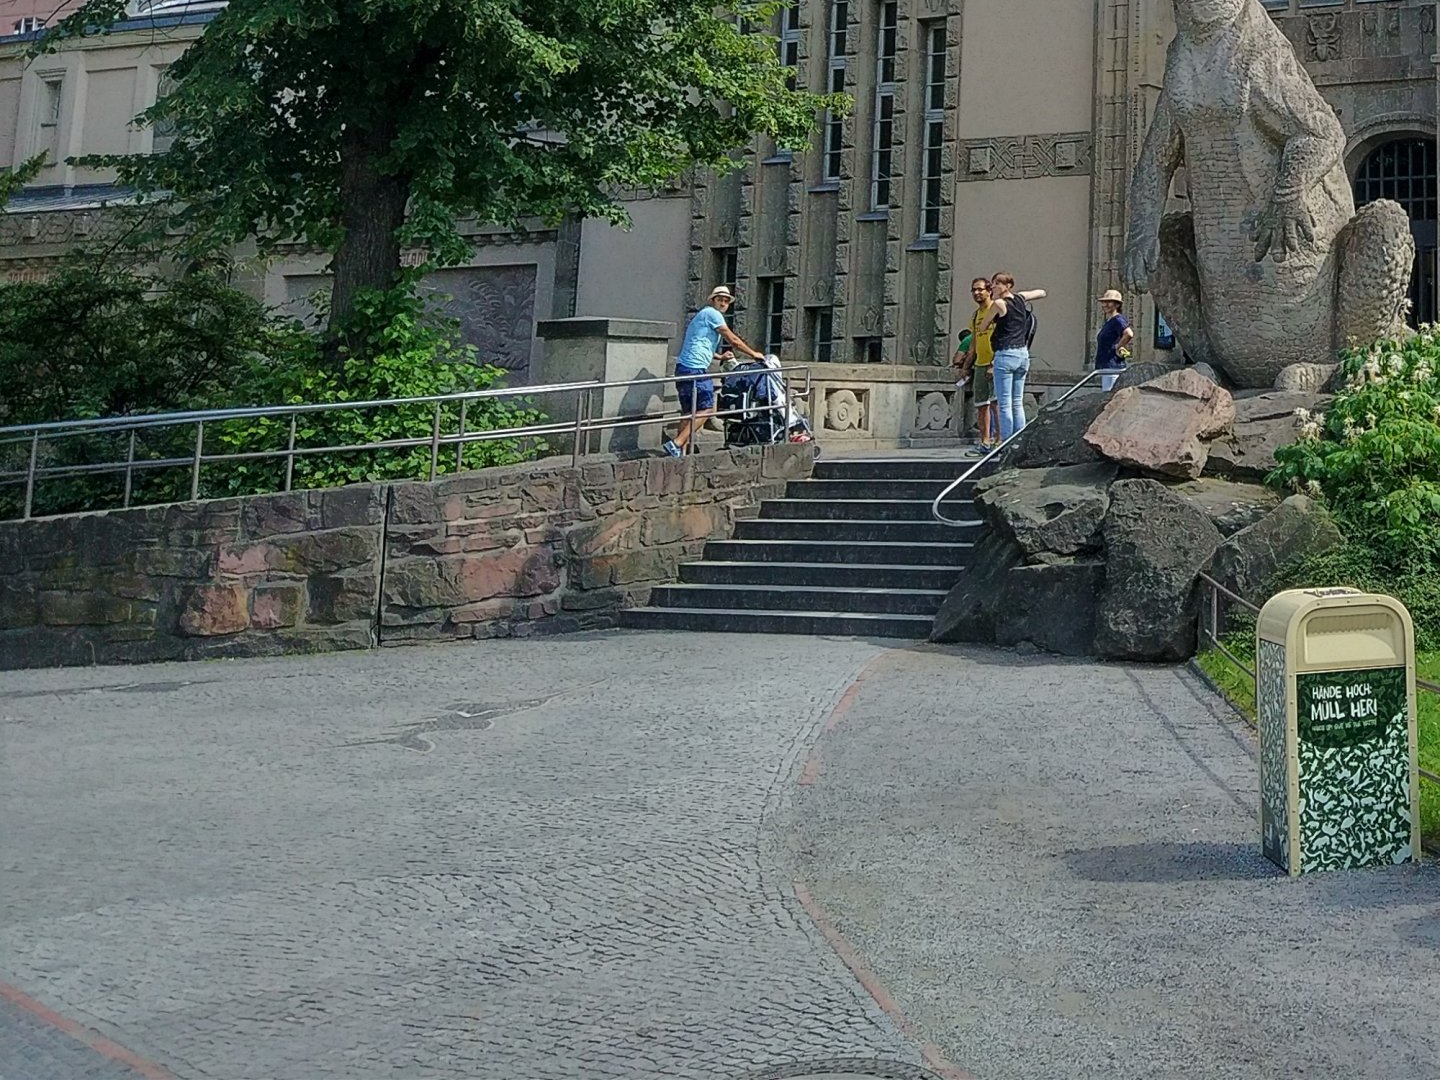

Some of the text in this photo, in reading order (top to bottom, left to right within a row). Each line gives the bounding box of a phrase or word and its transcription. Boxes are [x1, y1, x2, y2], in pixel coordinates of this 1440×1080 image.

[1312, 684, 1343, 700] HÄNDE
[1311, 698, 1378, 721] MÜLL HER!
